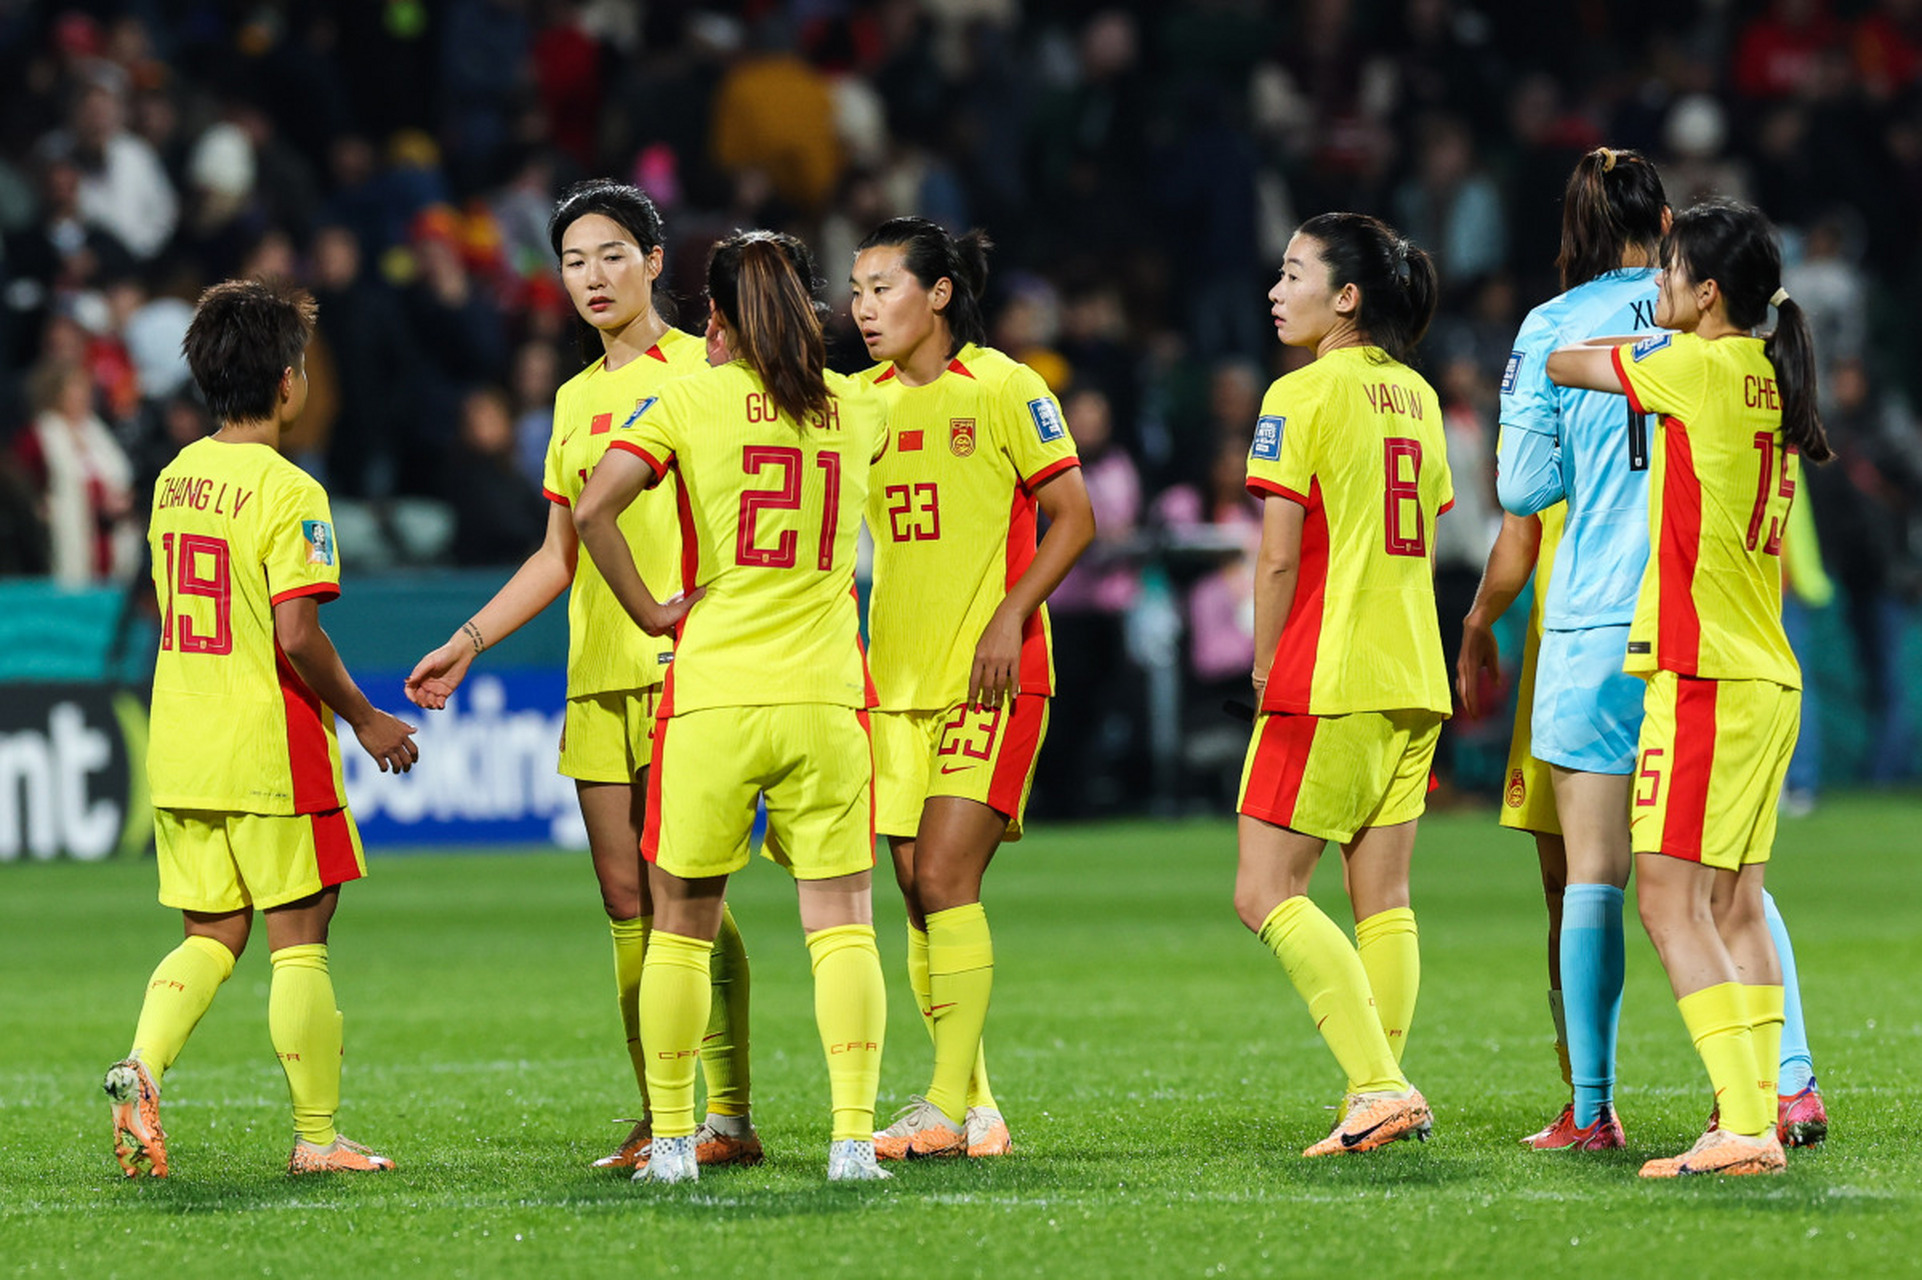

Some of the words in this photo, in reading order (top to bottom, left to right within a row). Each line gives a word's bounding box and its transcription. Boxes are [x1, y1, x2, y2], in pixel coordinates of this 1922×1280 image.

[1362, 383, 1405, 414] YAO
[1744, 375, 1783, 410] CHE
[159, 477, 213, 511] ZHANG
[736, 445, 840, 571] 21
[885, 483, 940, 542] 23
[1384, 437, 1426, 558] 8
[1746, 431, 1799, 556] 15
[162, 532, 232, 655] 19
[938, 702, 1001, 761] 23
[1636, 748, 1664, 806] 5
[831, 1041, 877, 1055] CFA
